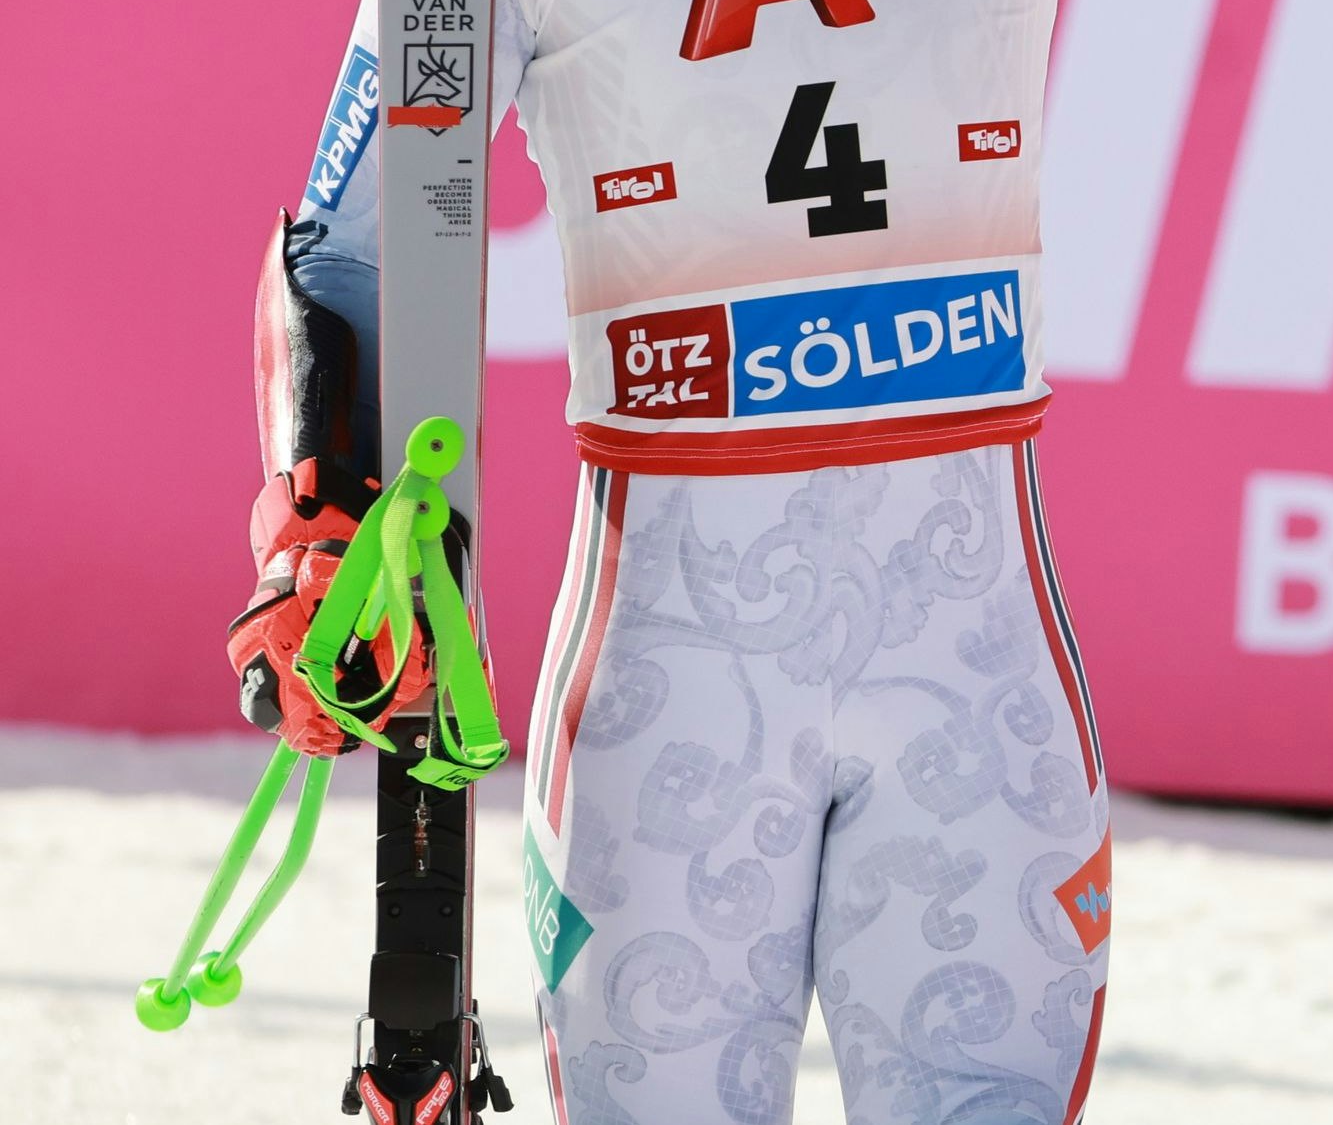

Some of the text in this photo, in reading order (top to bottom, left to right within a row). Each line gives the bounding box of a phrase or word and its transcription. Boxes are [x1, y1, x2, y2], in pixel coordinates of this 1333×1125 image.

[403, 14, 474, 32] DEER
[312, 69, 380, 204] KPMG
[765, 81, 888, 238] 4
[967, 127, 1017, 154] Tirol
[601, 170, 664, 201] Tirol
[627, 328, 712, 376] ÖTZ
[744, 281, 1018, 401] SÖLDEN
[523, 854, 560, 955] DNB
[416, 1077, 450, 1125] RACE
